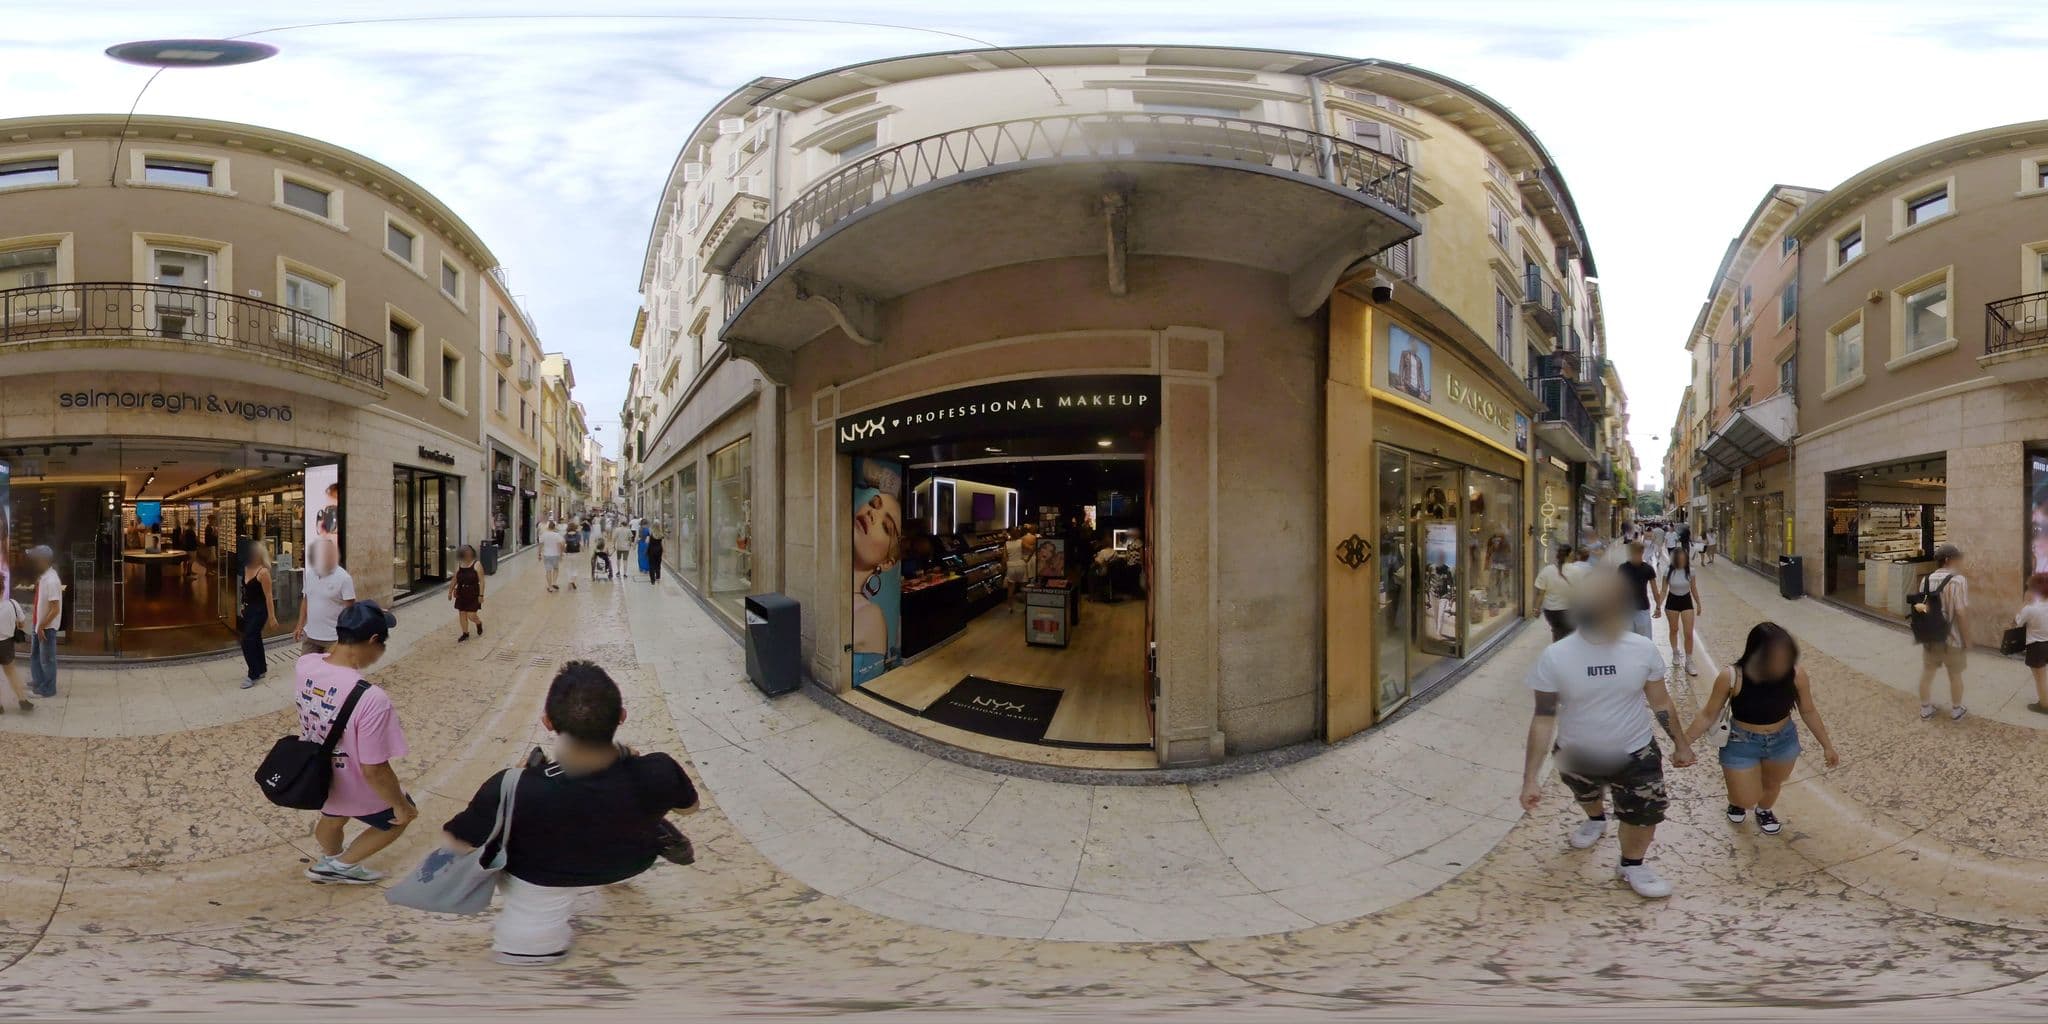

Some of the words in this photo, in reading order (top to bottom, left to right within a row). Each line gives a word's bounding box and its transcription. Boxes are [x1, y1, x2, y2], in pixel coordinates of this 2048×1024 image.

[60, 388, 201, 414] salmoiraghi
[206, 394, 222, 412] &
[1447, 373, 1510, 432] BARONE
[840, 416, 886, 443] NYX
[906, 398, 1044, 426] PROFESSIONAL
[1058, 394, 1148, 407] MAKEUP
[1587, 665, 1617, 676] IUTER
[972, 696, 1025, 713] NYX
